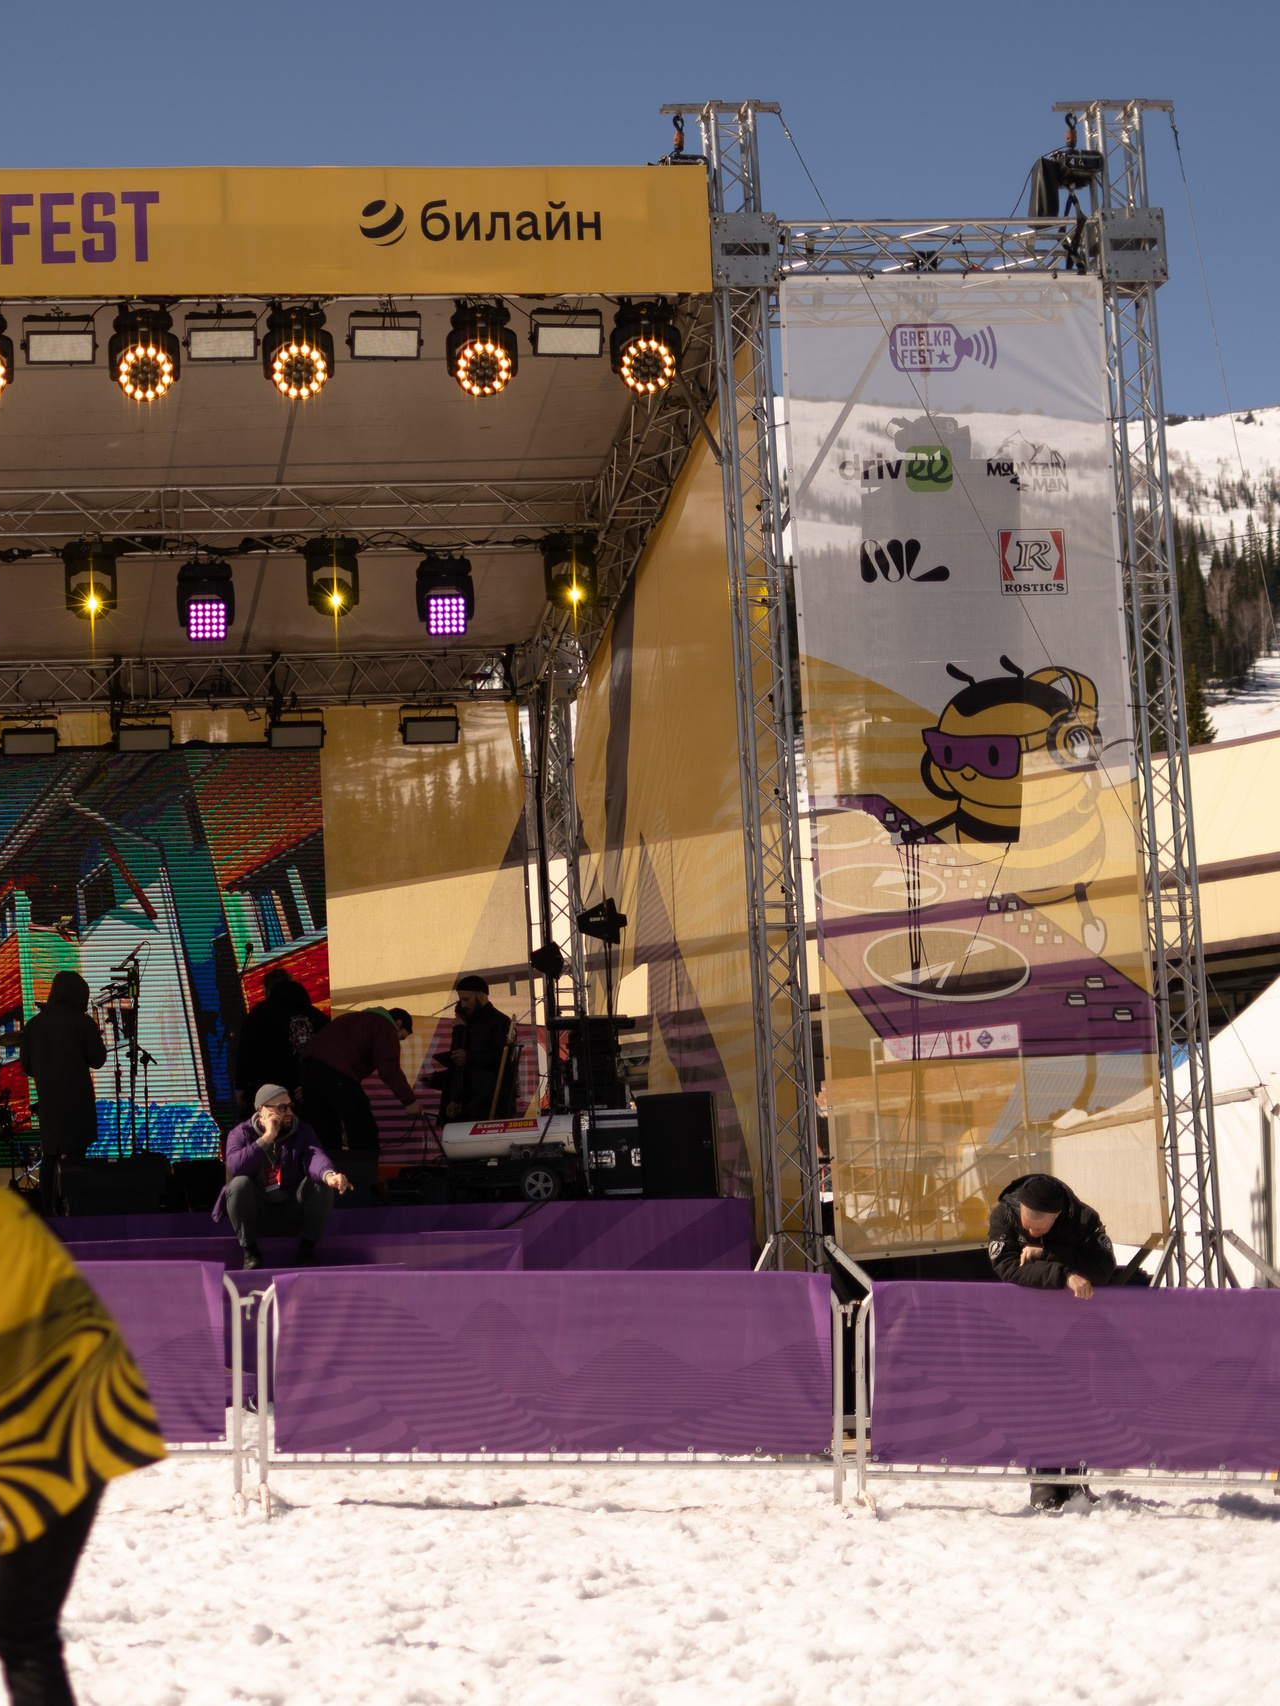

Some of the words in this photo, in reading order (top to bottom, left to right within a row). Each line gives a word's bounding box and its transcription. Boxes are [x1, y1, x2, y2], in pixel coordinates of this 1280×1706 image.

[421, 199, 602, 243] билайн
[899, 330, 951, 346] GRELKA
[901, 348, 935, 365] FEST
[838, 451, 954, 484] drivee
[986, 461, 1068, 478] MOUNTAIN
[1033, 477, 1070, 493] MAN
[1004, 583, 1065, 593] ROSTIC'S
[507, 1120, 534, 1128] 30000
